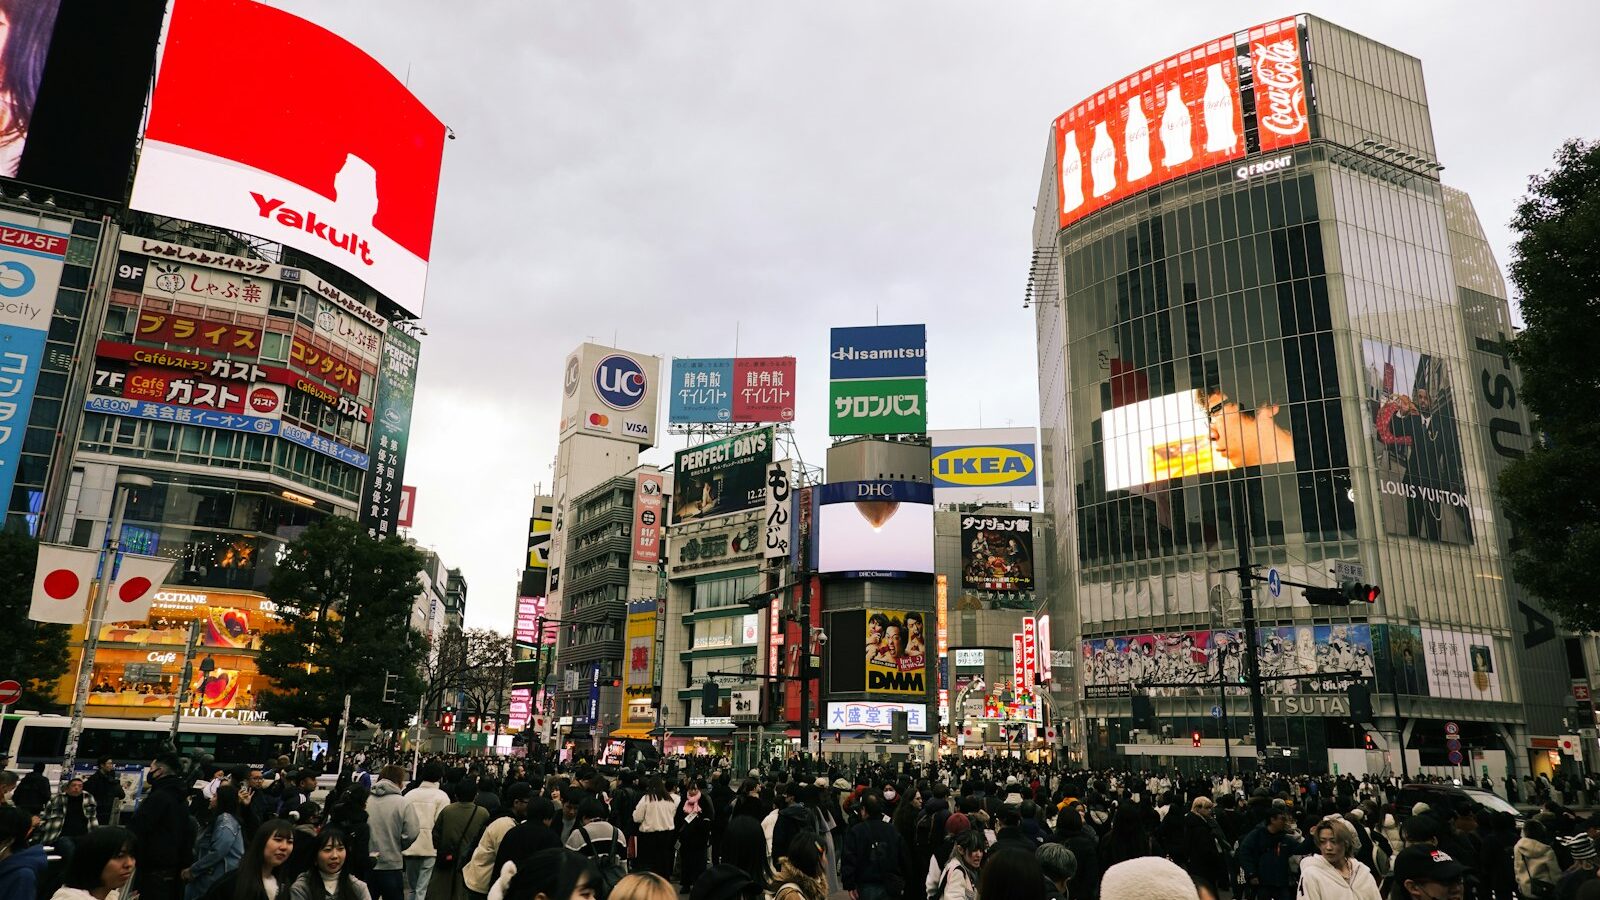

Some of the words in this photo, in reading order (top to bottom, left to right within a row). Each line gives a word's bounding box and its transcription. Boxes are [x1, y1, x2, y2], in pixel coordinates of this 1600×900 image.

[249, 191, 374, 266] Yakult
[0, 229, 59, 250] ビル5F
[142, 240, 269, 273] しゃぶしゃぶバイキング
[118, 264, 143, 281] 9F
[190, 273, 262, 304] しゃぶ葉
[140, 314, 256, 350] プライス
[338, 318, 379, 353] しゃぶ葉
[384, 342, 416, 369] PERFECT
[831, 346, 925, 360] Hisamitsu
[210, 359, 267, 383] ガスト
[291, 340, 357, 387] コンタクト
[390, 358, 409, 377] DAYS
[95, 370, 126, 388] 7F
[131, 375, 164, 390] Café
[684, 371, 721, 388] 龍角散
[746, 370, 784, 387] 龍角散
[130, 387, 163, 398] レストラン
[165, 378, 240, 409] ガスト
[252, 397, 276, 407] ガスト
[678, 389, 727, 404] ダイレクト
[741, 388, 790, 404] ダイレクト
[91, 398, 131, 412] AEON
[338, 397, 368, 421] ガスト
[835, 394, 921, 418] サロンパス
[285, 425, 308, 443] AEON
[625, 422, 648, 434] VISA
[680, 442, 730, 473] PERFECT
[733, 433, 767, 458] DAYS
[938, 456, 1027, 475] IKEA
[747, 487, 766, 500] 12.22
[857, 483, 893, 496] DHC
[1380, 479, 1417, 498] LOUIS
[1418, 486, 1469, 507] VUITTON
[1475, 330, 1556, 649] TSUA
[766, 462, 790, 554] もんじゃ
[962, 516, 1030, 532] ダンジョン飯
[147, 652, 176, 664] Café
[869, 670, 925, 691] DMM
[1270, 697, 1374, 713] TSUTA
